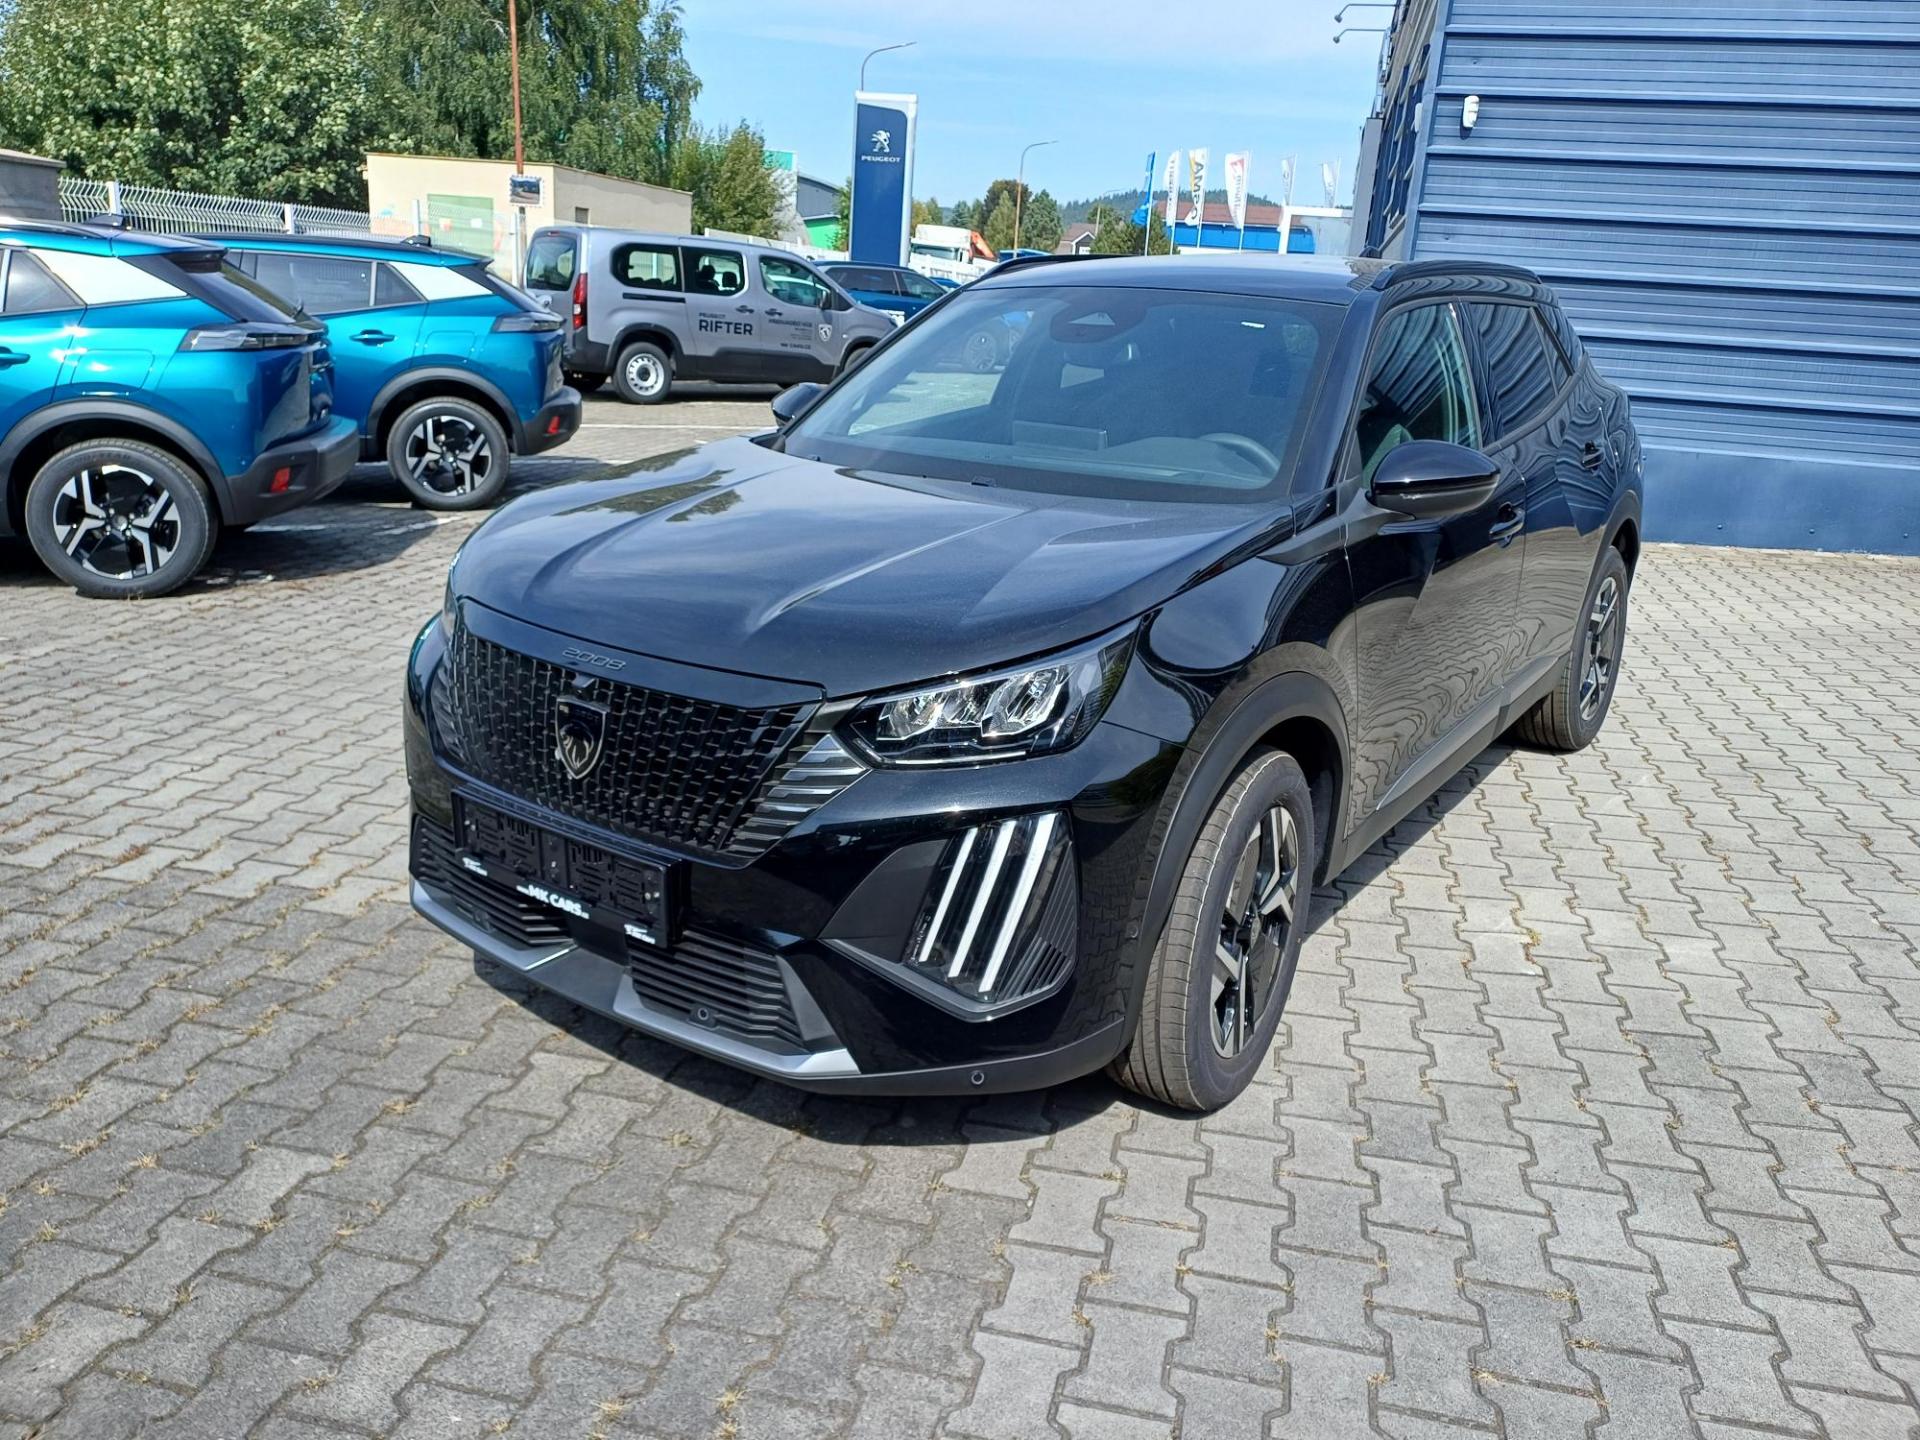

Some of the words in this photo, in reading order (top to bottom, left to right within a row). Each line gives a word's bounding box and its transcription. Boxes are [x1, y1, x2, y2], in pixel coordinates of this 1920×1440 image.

[861, 155, 901, 163] PEUGEOT
[698, 319, 754, 336] RIFTER
[562, 647, 627, 670] 2008
